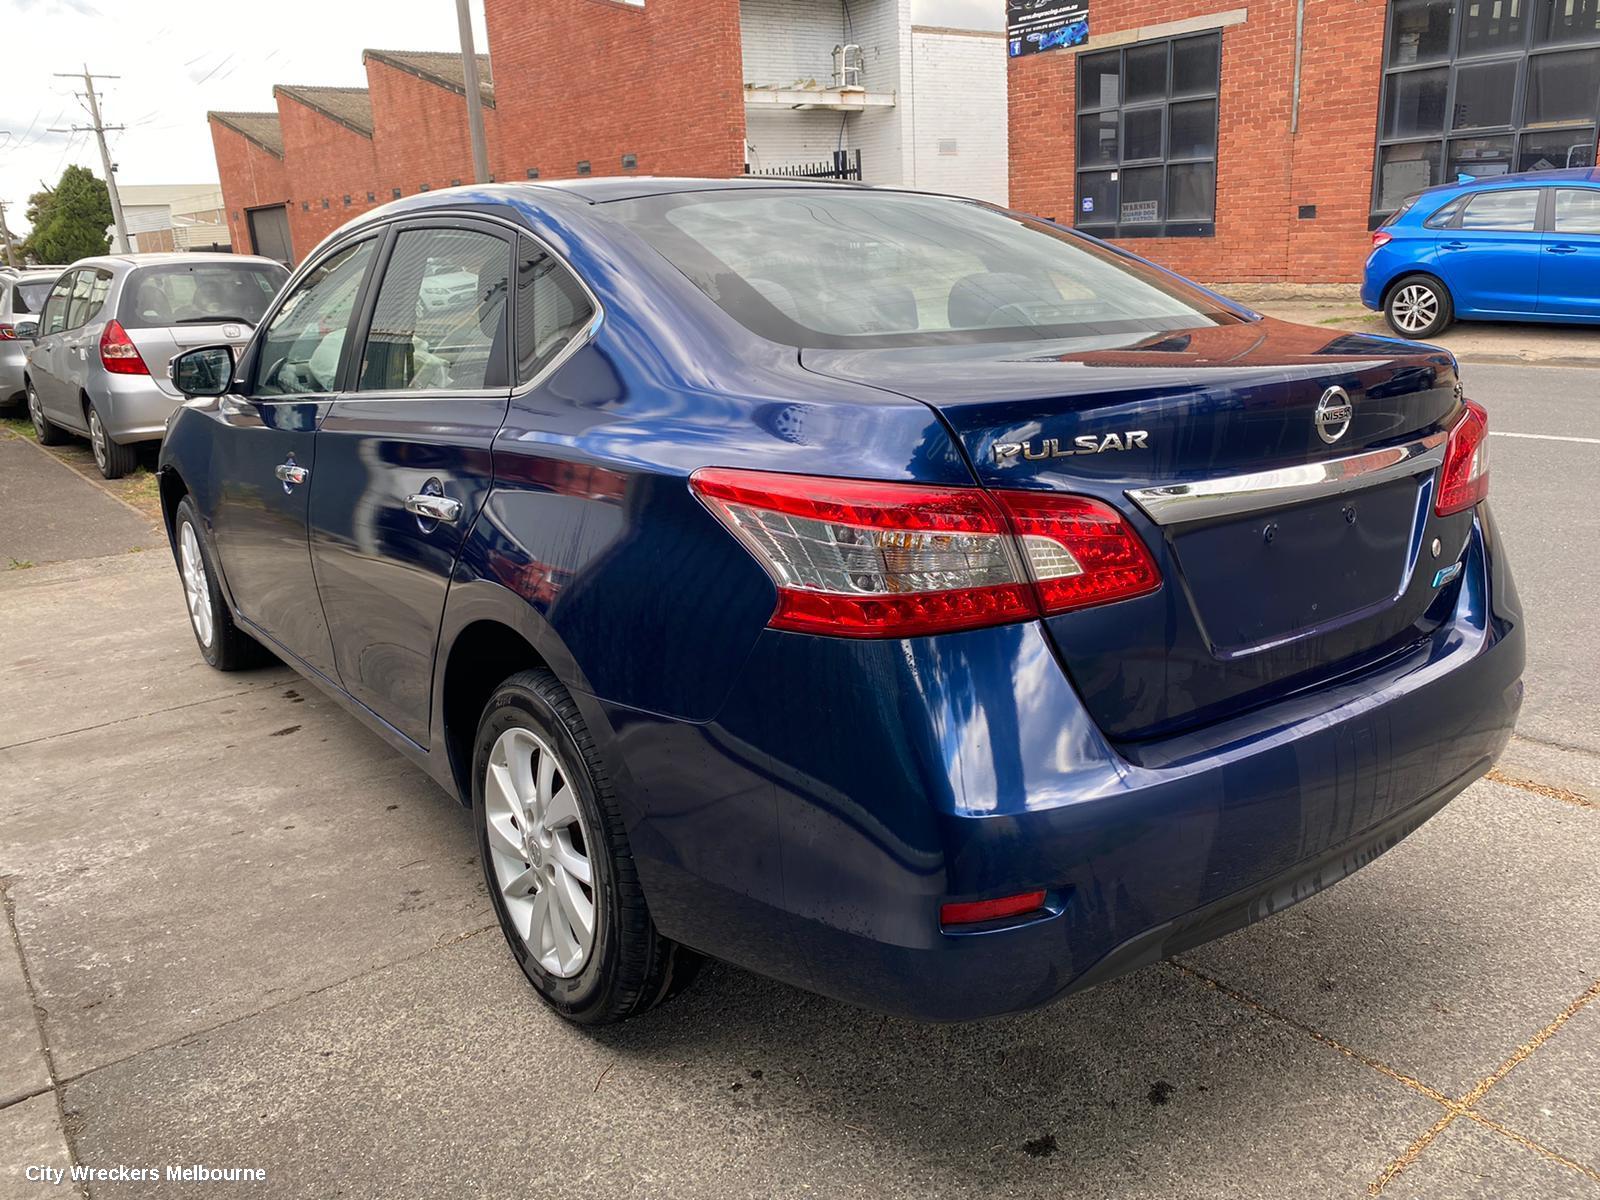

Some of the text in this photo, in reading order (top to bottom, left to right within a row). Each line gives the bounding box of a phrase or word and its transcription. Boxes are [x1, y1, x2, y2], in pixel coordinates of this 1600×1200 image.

[1122, 202, 1156, 211] WARNING
[1322, 406, 1352, 421] NISSAN
[991, 429, 1149, 464] PULSAR
